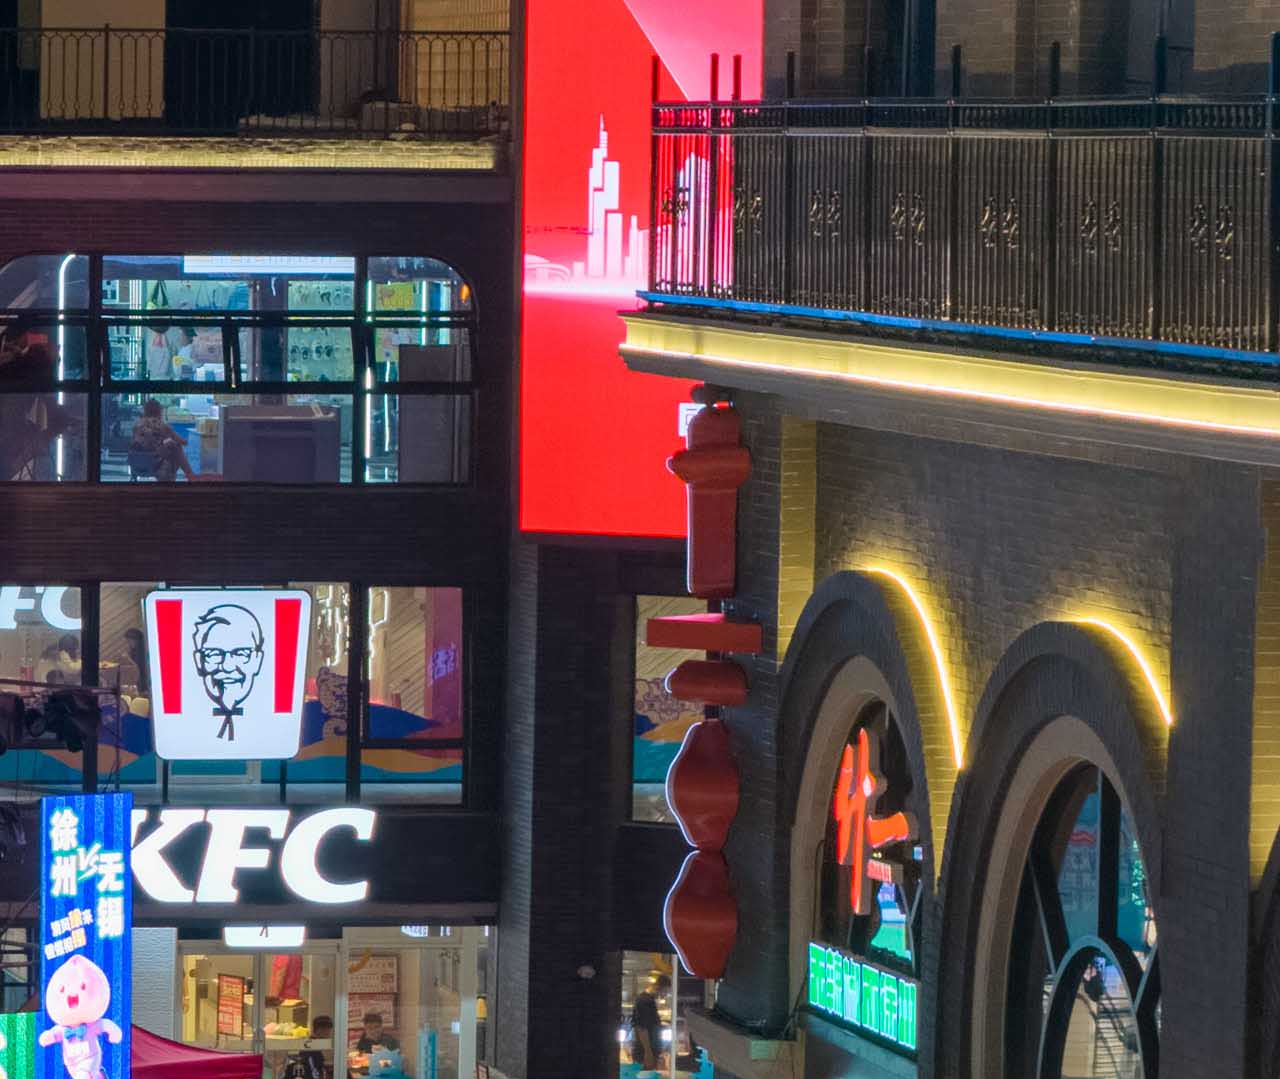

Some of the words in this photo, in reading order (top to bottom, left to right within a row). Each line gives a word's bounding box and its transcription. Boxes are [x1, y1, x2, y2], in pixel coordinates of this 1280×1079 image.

[49, 808, 78, 898] 徐州
[97, 851, 124, 937] 无锡
[131, 808, 377, 904] KFC
